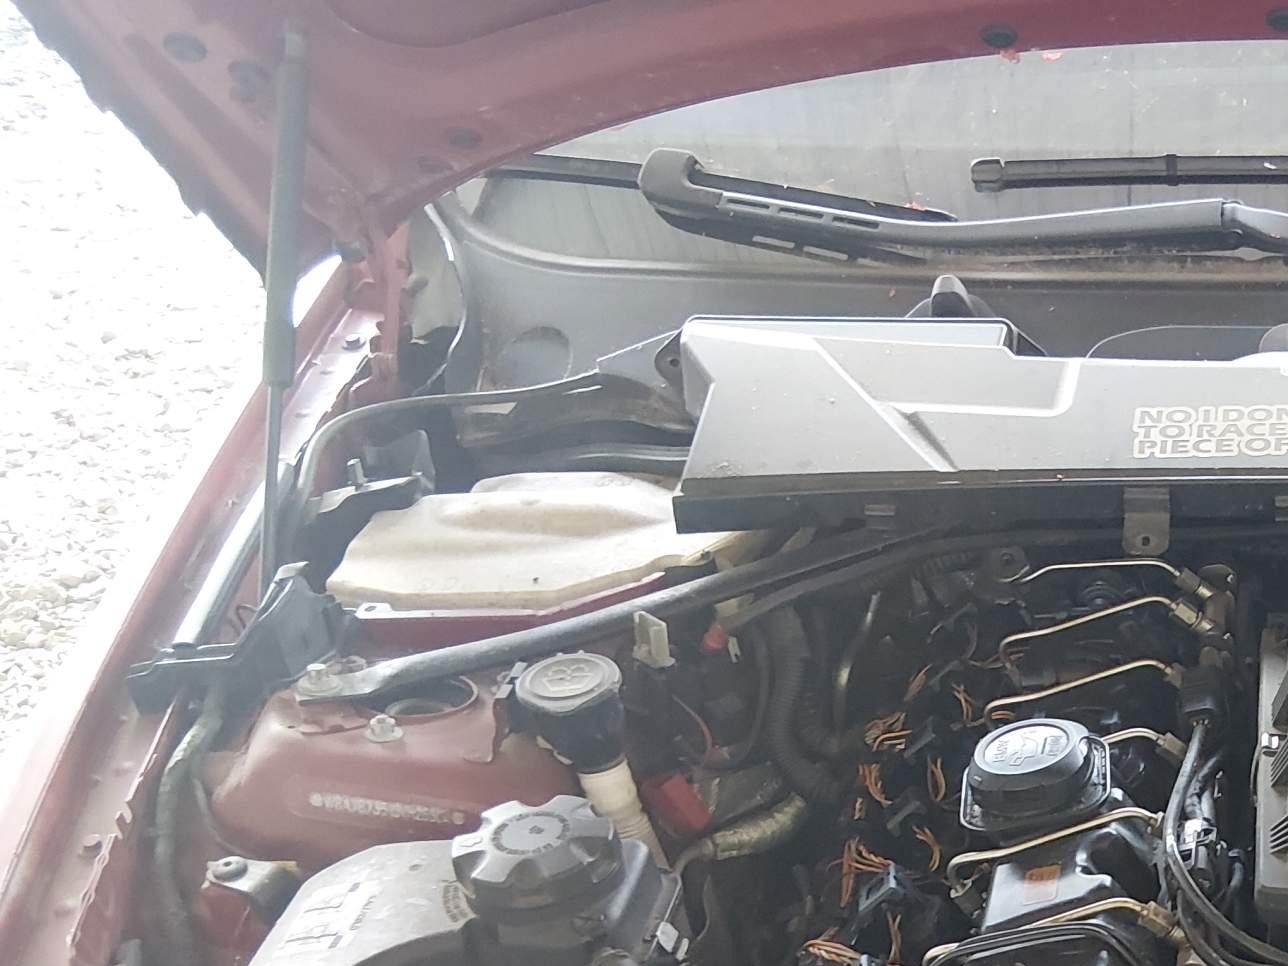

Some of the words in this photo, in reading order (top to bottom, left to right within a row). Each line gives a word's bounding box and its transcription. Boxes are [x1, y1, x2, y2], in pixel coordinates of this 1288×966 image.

[1138, 409, 1192, 424] NO
[1136, 422, 1186, 438] TO
[1196, 421, 1288, 437] RACE
[1137, 438, 1235, 455] PIECE
